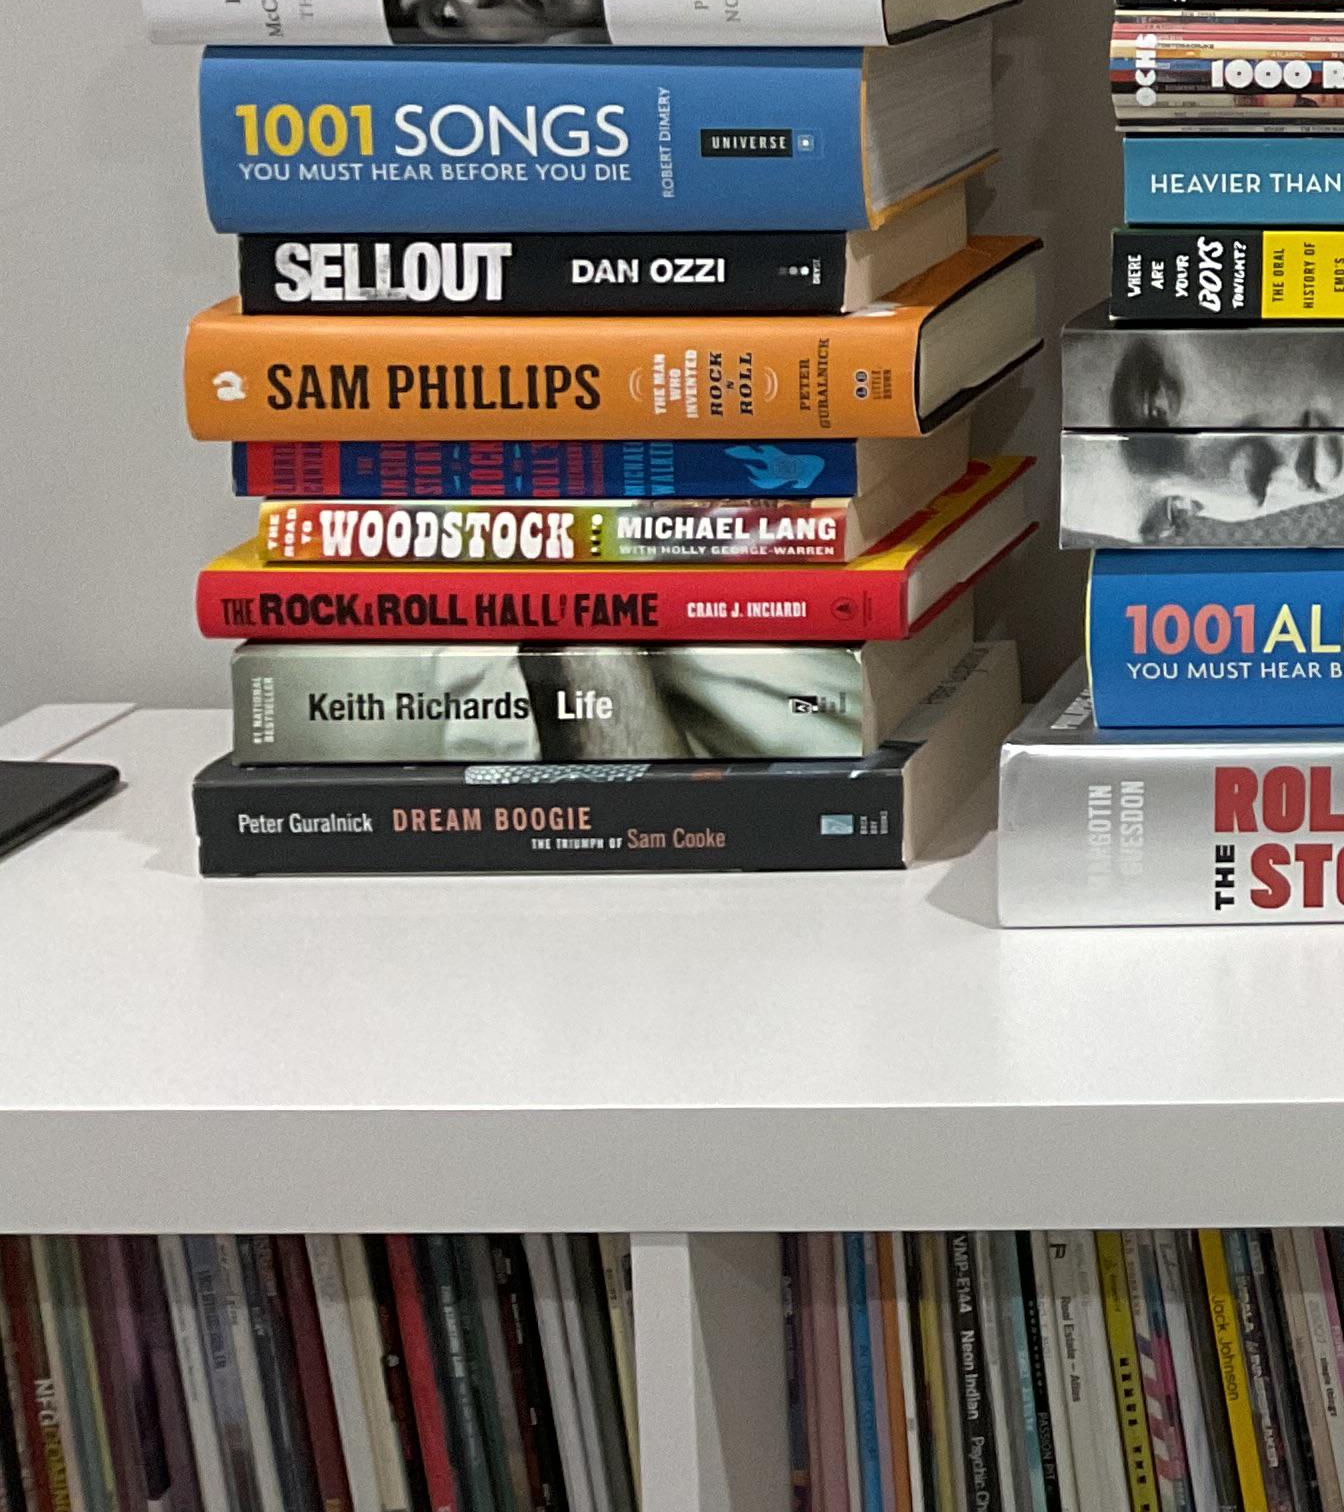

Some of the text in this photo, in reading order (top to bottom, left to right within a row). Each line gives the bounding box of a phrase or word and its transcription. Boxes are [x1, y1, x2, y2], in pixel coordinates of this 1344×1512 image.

[1150, 173, 1260, 195] HEAVIER
[1270, 173, 1343, 194] THAN
[267, 363, 601, 410] SAM PHILLIPS
[308, 692, 530, 721] Keith Richards
[558, 690, 613, 720] Life
[239, 812, 374, 834] Peter Guralnick
[392, 807, 592, 832] DREAM BOOGIE
[1212, 1295, 1239, 1401] Jack Johnson
[961, 1330, 981, 1421] Neon Indian
